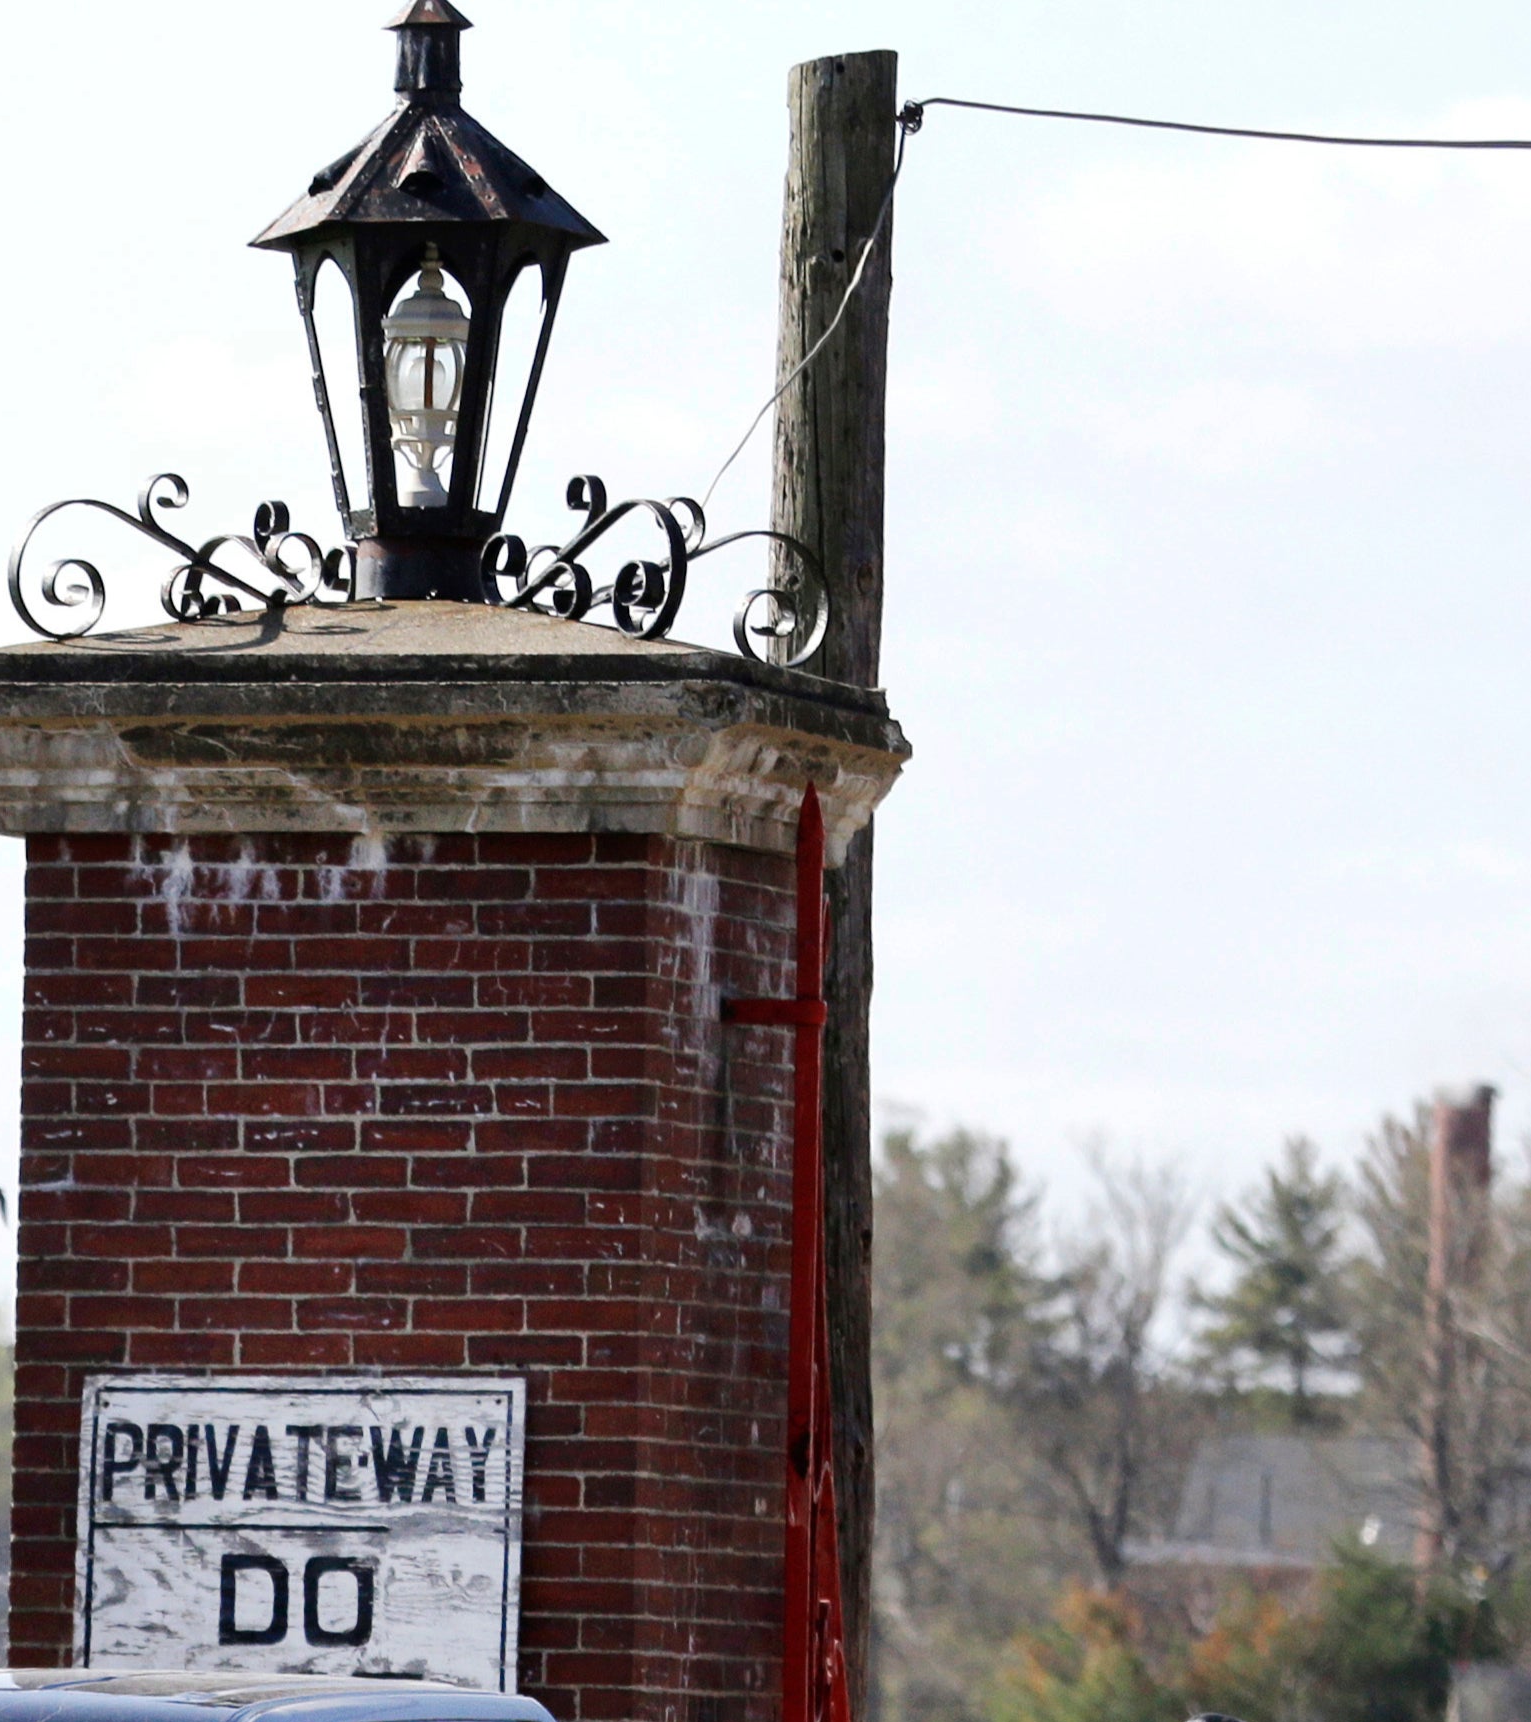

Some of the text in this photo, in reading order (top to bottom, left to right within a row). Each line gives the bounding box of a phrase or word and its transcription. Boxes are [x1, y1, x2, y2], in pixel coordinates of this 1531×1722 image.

[102, 1422, 496, 1503] PRIVATE WAY
[218, 1553, 378, 1647] DO
